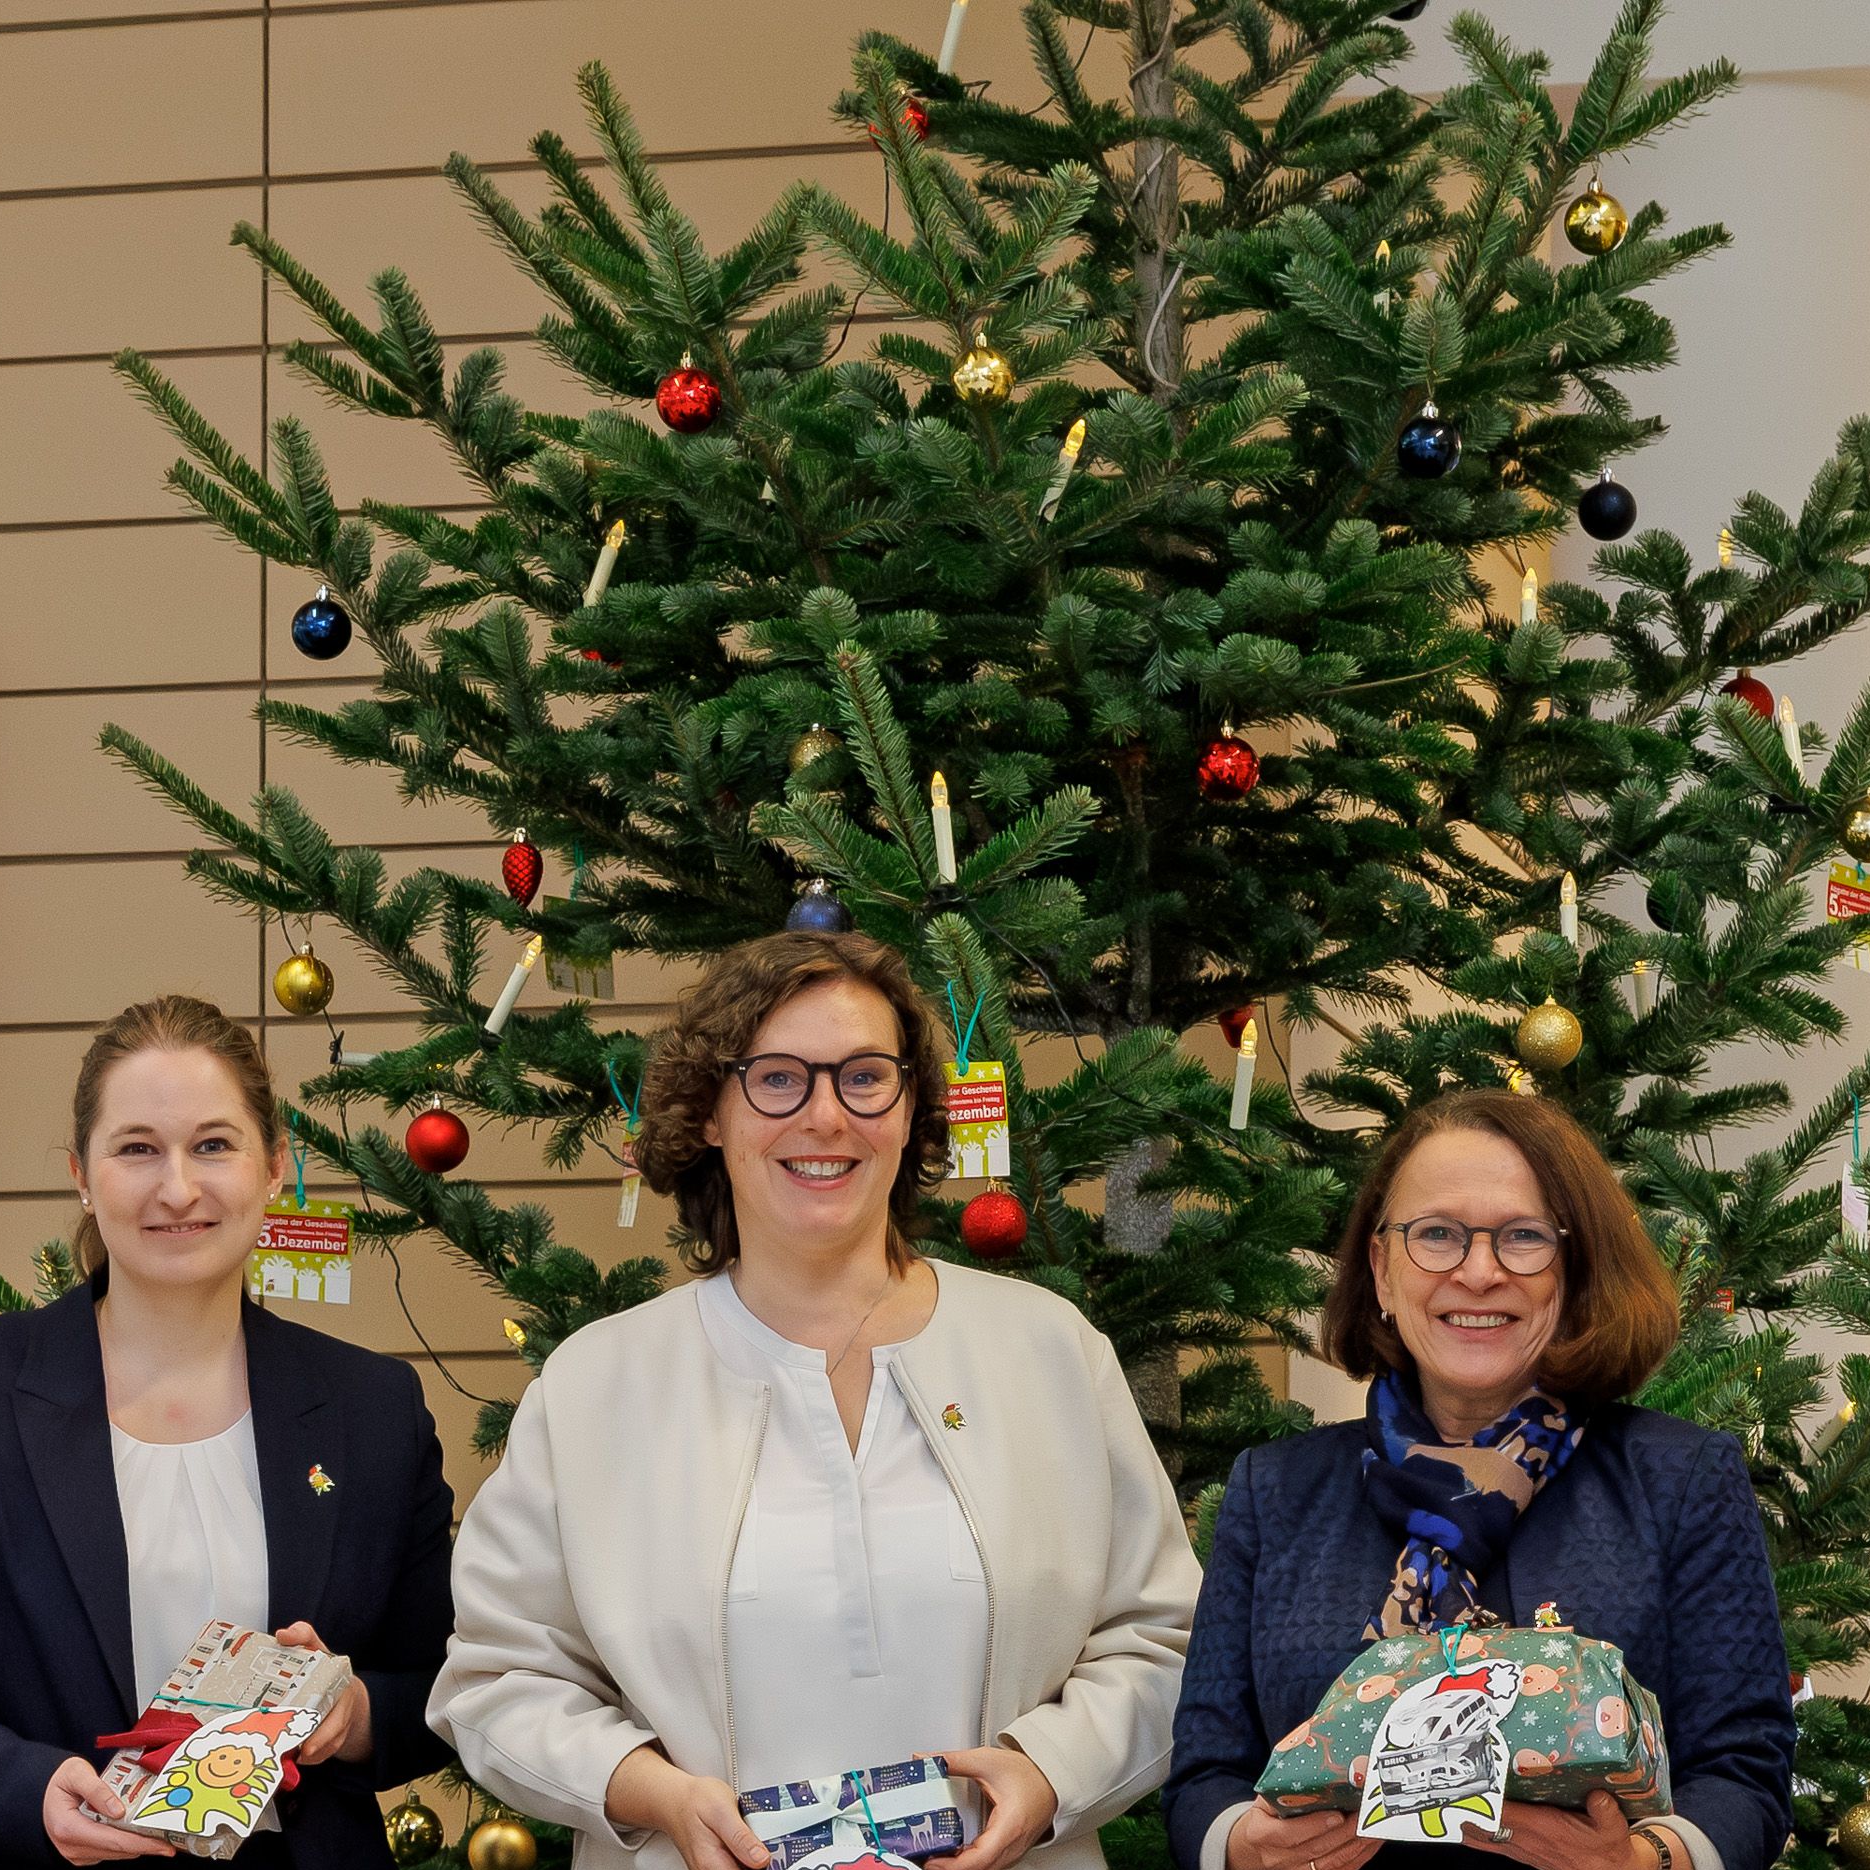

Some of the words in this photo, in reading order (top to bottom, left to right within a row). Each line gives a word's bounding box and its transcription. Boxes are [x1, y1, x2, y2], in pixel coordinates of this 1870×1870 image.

[1829, 893, 1841, 917] 5.
[962, 1085, 1002, 1095] Geschenke
[946, 1105, 1004, 1121] ezember
[278, 1235, 347, 1251] Dezember
